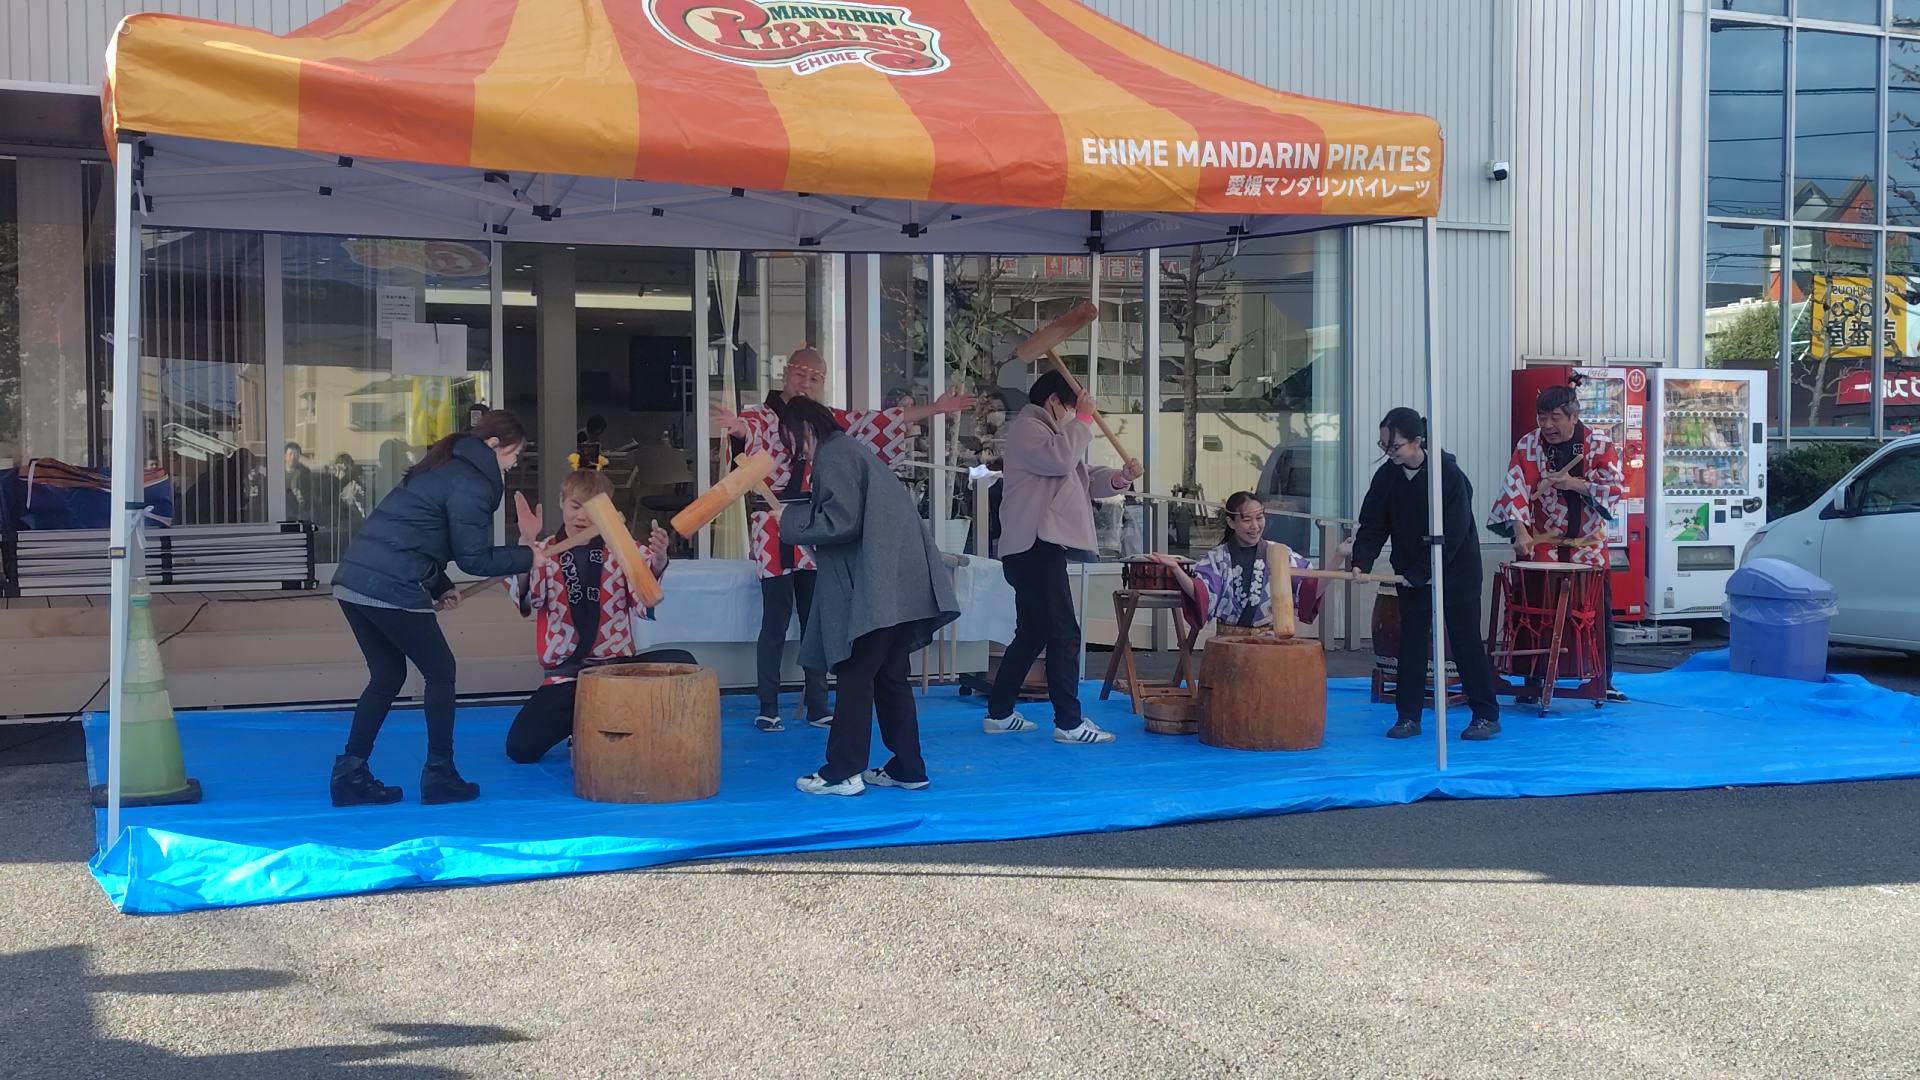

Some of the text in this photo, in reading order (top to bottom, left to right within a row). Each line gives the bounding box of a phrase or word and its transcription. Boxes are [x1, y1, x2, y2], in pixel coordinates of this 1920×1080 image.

[768, 6, 897, 26] MANDARIN
[655, 0, 929, 60] PIRATES
[795, 51, 860, 73] EHIME
[1082, 137, 1431, 173] EHIME MANDARIN PIRATES
[1225, 174, 1431, 199] 愛媛マンダリンパイレーツ
